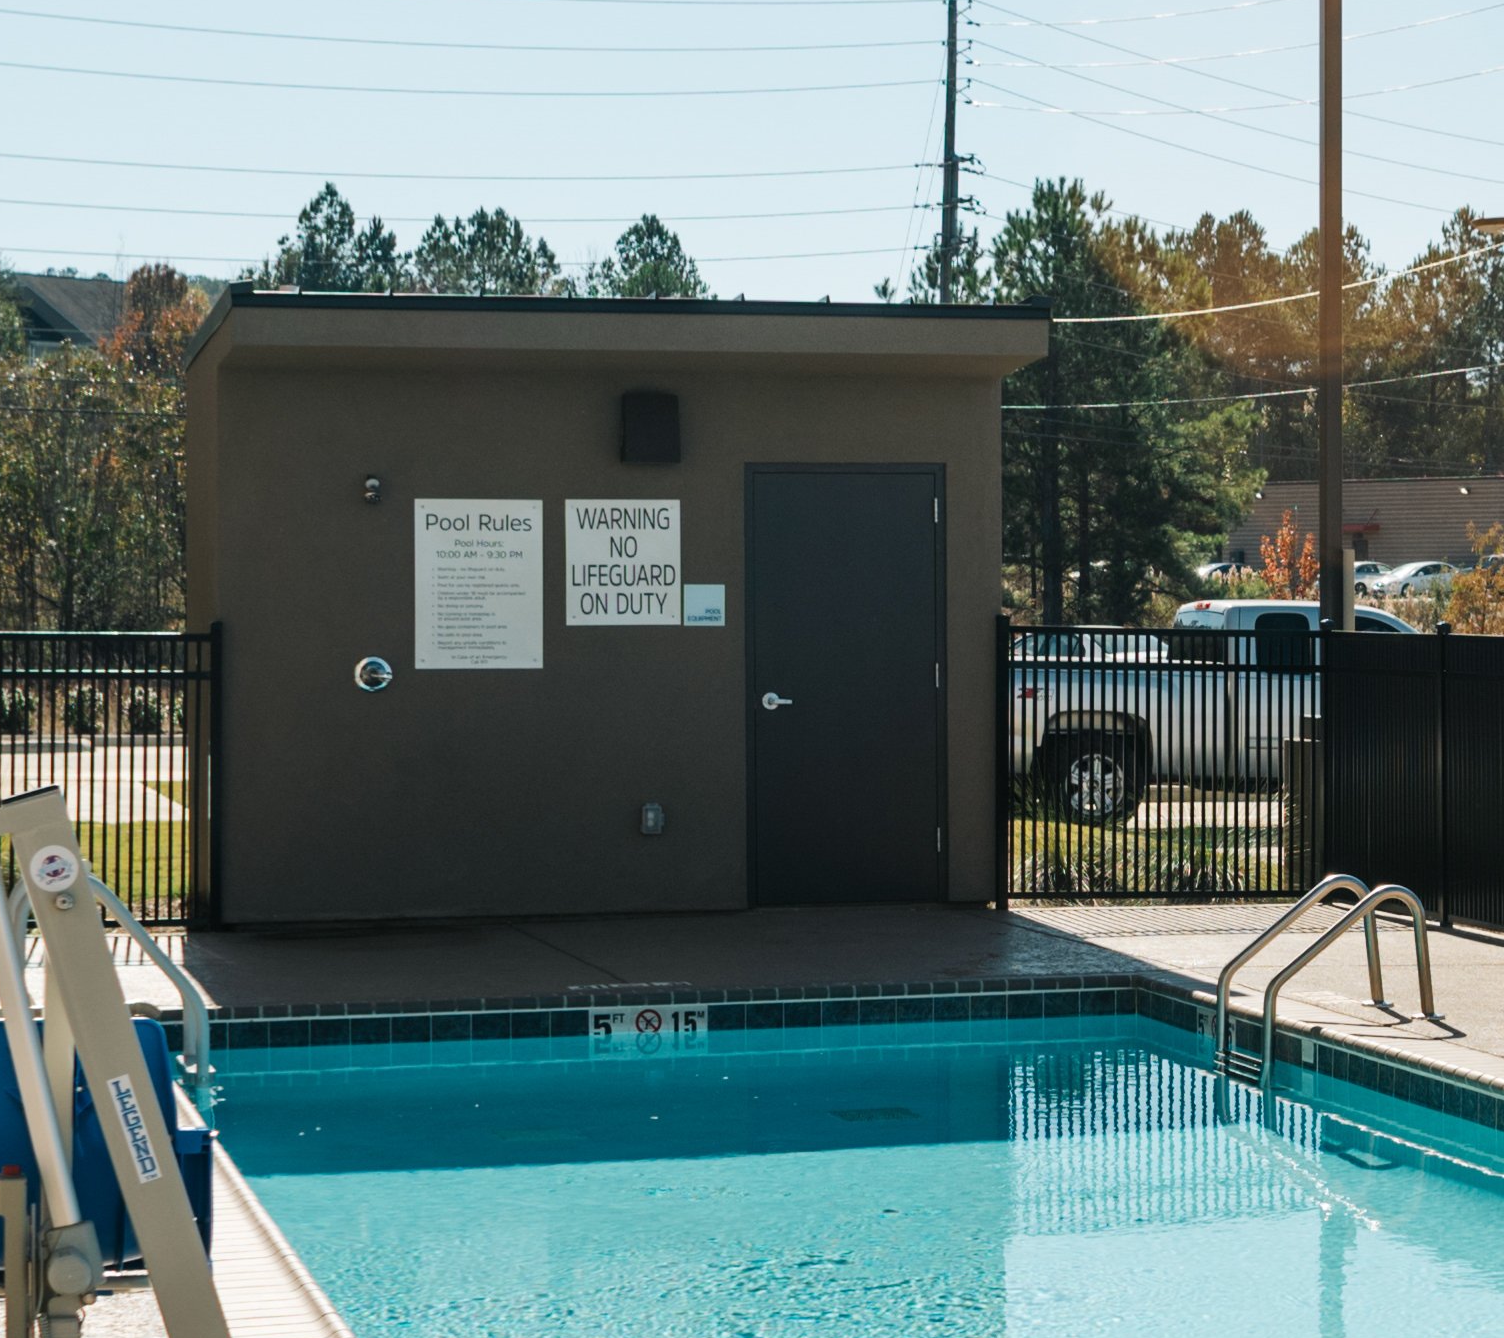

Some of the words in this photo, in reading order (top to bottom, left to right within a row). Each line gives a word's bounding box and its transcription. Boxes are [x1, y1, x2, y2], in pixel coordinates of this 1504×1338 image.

[425, 513, 470, 531] Pool
[479, 514, 533, 532] Rules
[576, 508, 670, 530] WARNING
[454, 539, 474, 548] Pool
[463, 550, 477, 559] AM
[509, 550, 523, 559] PM
[610, 535, 638, 558] NO
[572, 564, 676, 586] LIFEGUARD
[580, 592, 608, 615] ON
[616, 592, 668, 615] DUTY
[112, 1081, 157, 1175] LEGEND
